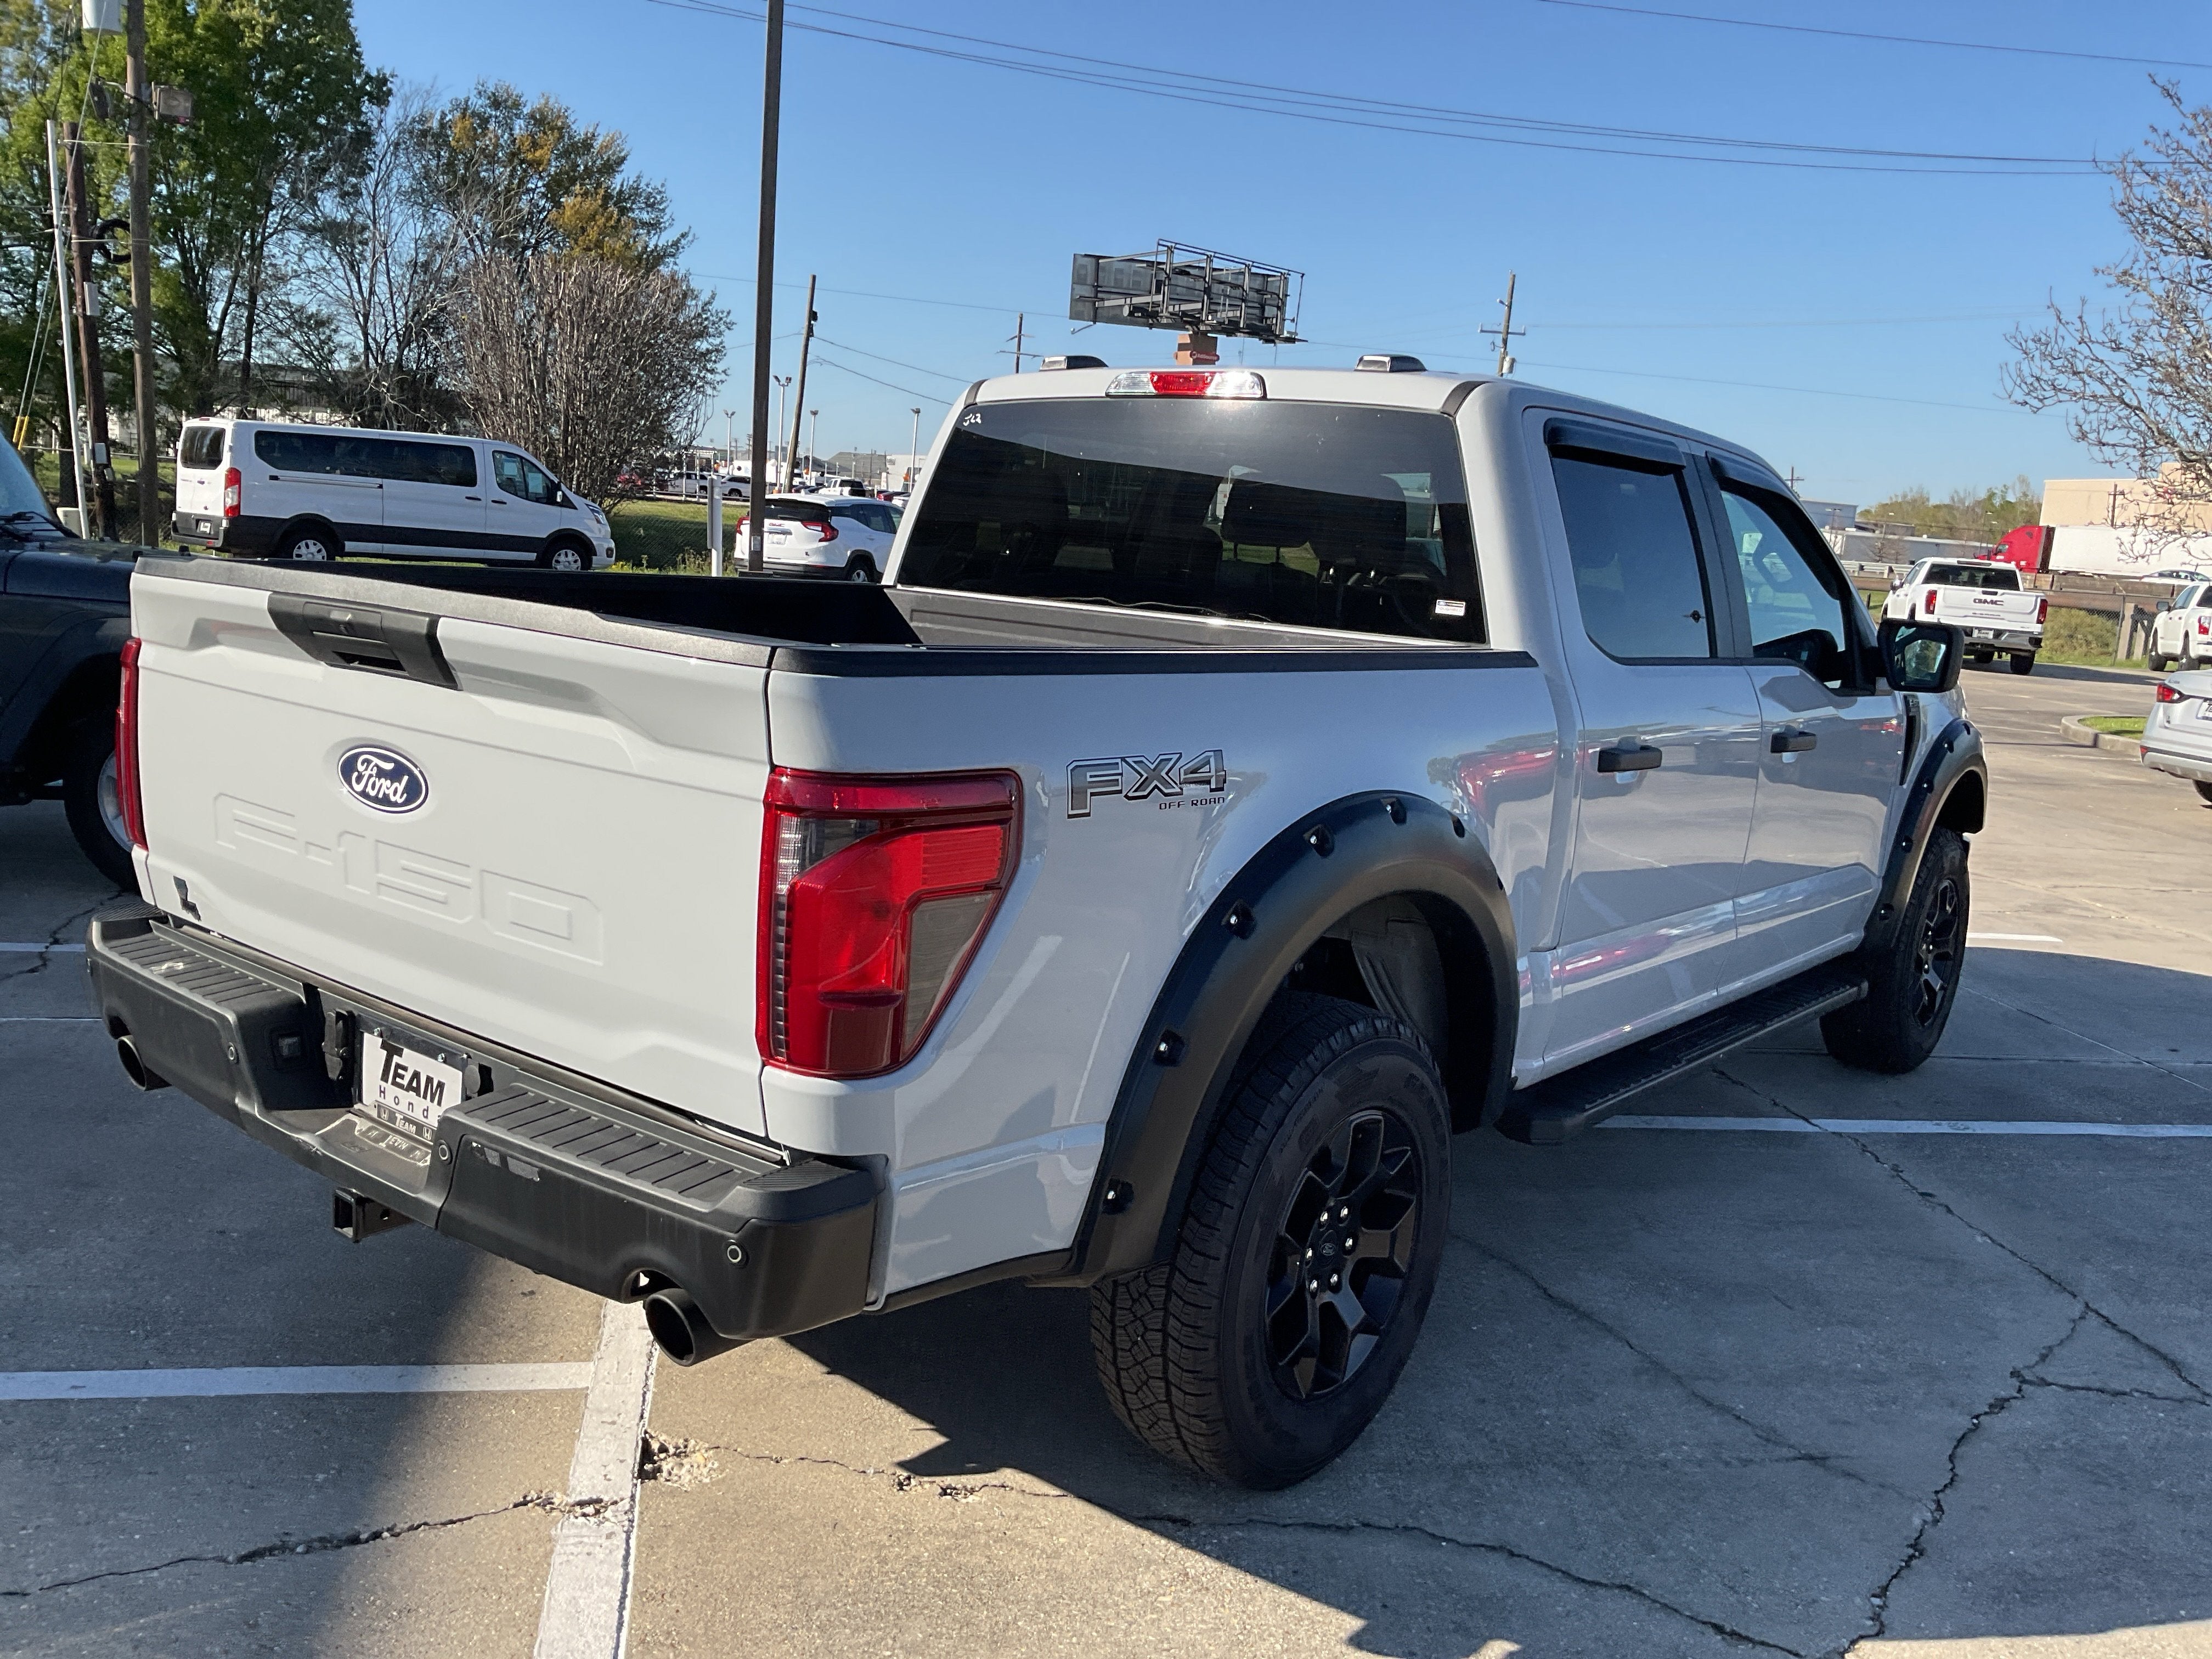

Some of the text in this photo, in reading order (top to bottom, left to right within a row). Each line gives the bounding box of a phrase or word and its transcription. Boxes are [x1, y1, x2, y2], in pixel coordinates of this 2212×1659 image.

[1973, 597, 2004, 606] GMC
[352, 754, 409, 803] Ford
[1066, 749, 1226, 819] FX4
[1159, 797, 1225, 810] OFF ROAD
[215, 793, 604, 967] F-150
[380, 1039, 446, 1107] TEAM
[379, 1085, 441, 1120] Hond
[395, 1113, 416, 1135] TEAM
